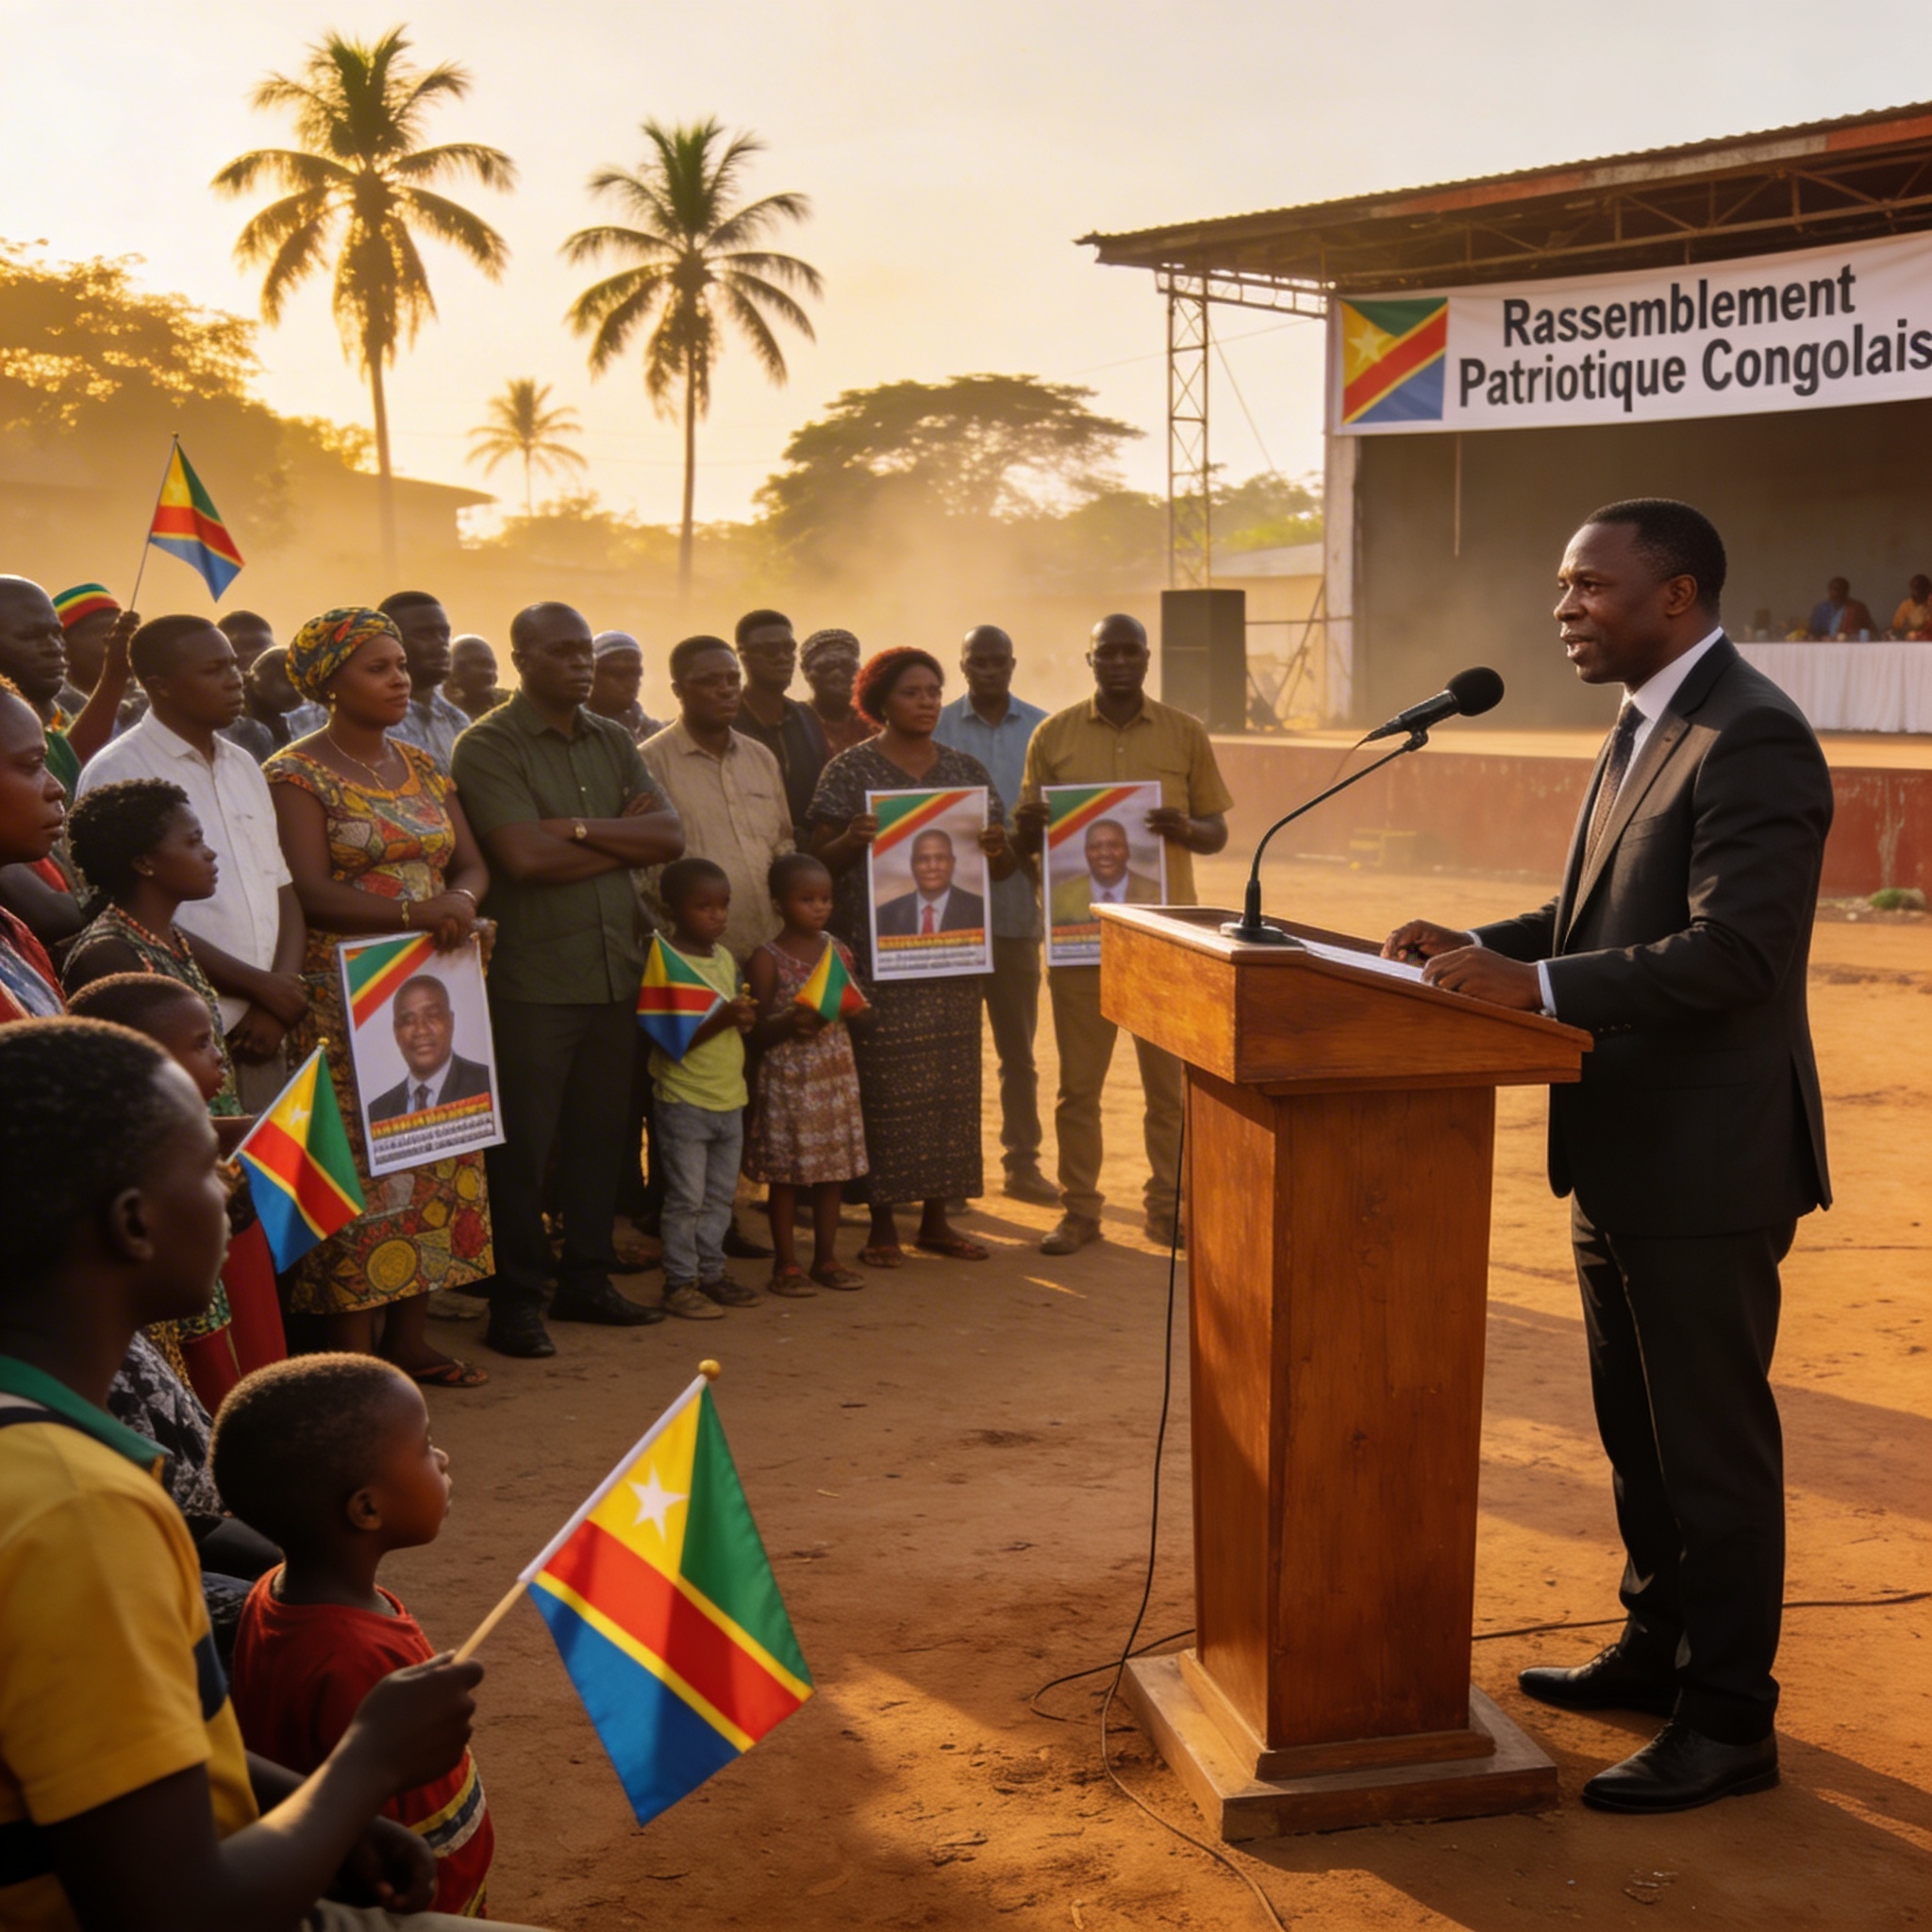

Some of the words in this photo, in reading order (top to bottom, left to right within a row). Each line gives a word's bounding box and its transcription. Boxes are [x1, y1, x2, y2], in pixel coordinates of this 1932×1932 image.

[1502, 263, 1857, 348] Rassemblement
[1459, 350, 1686, 413] Patriotique
[1702, 318, 1932, 397] Congolais
